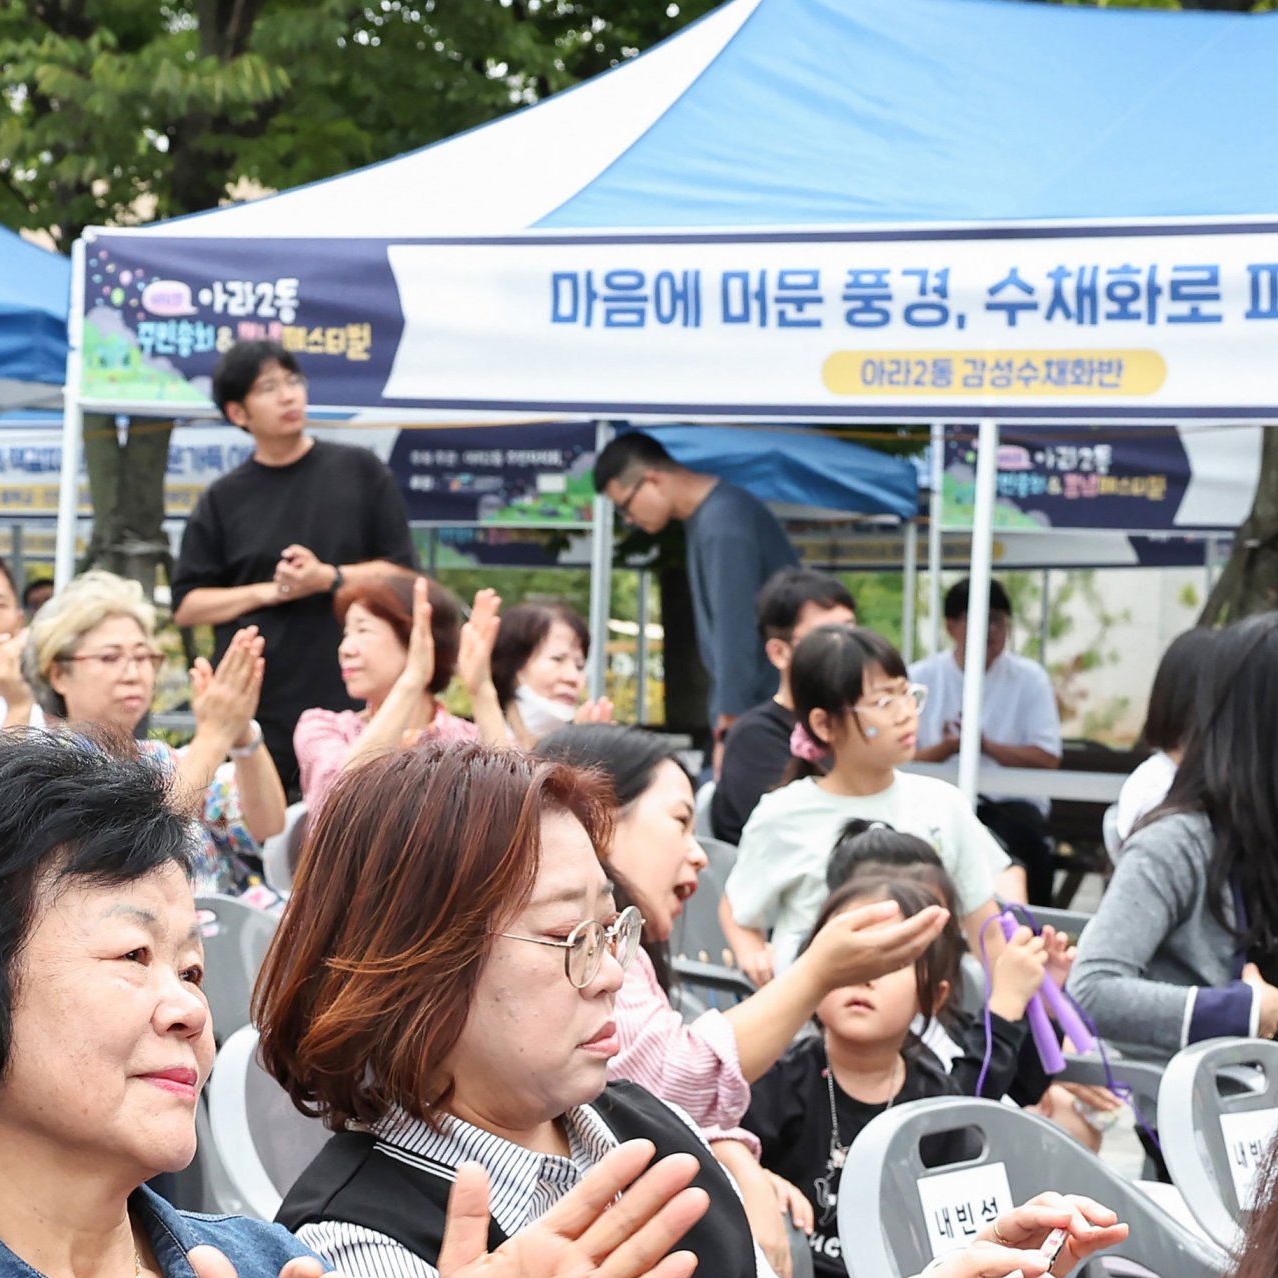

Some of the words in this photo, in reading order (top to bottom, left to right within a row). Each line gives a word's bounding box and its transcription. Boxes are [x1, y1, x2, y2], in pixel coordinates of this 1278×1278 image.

[198, 277, 301, 324] 아라2동
[551, 268, 701, 328] 마음에
[721, 268, 823, 328] 머문
[842, 265, 966, 330] 풍경,
[985, 264, 1223, 328] 수채화로
[860, 358, 953, 388] 아라2동
[961, 358, 1123, 389] 감성수채화반
